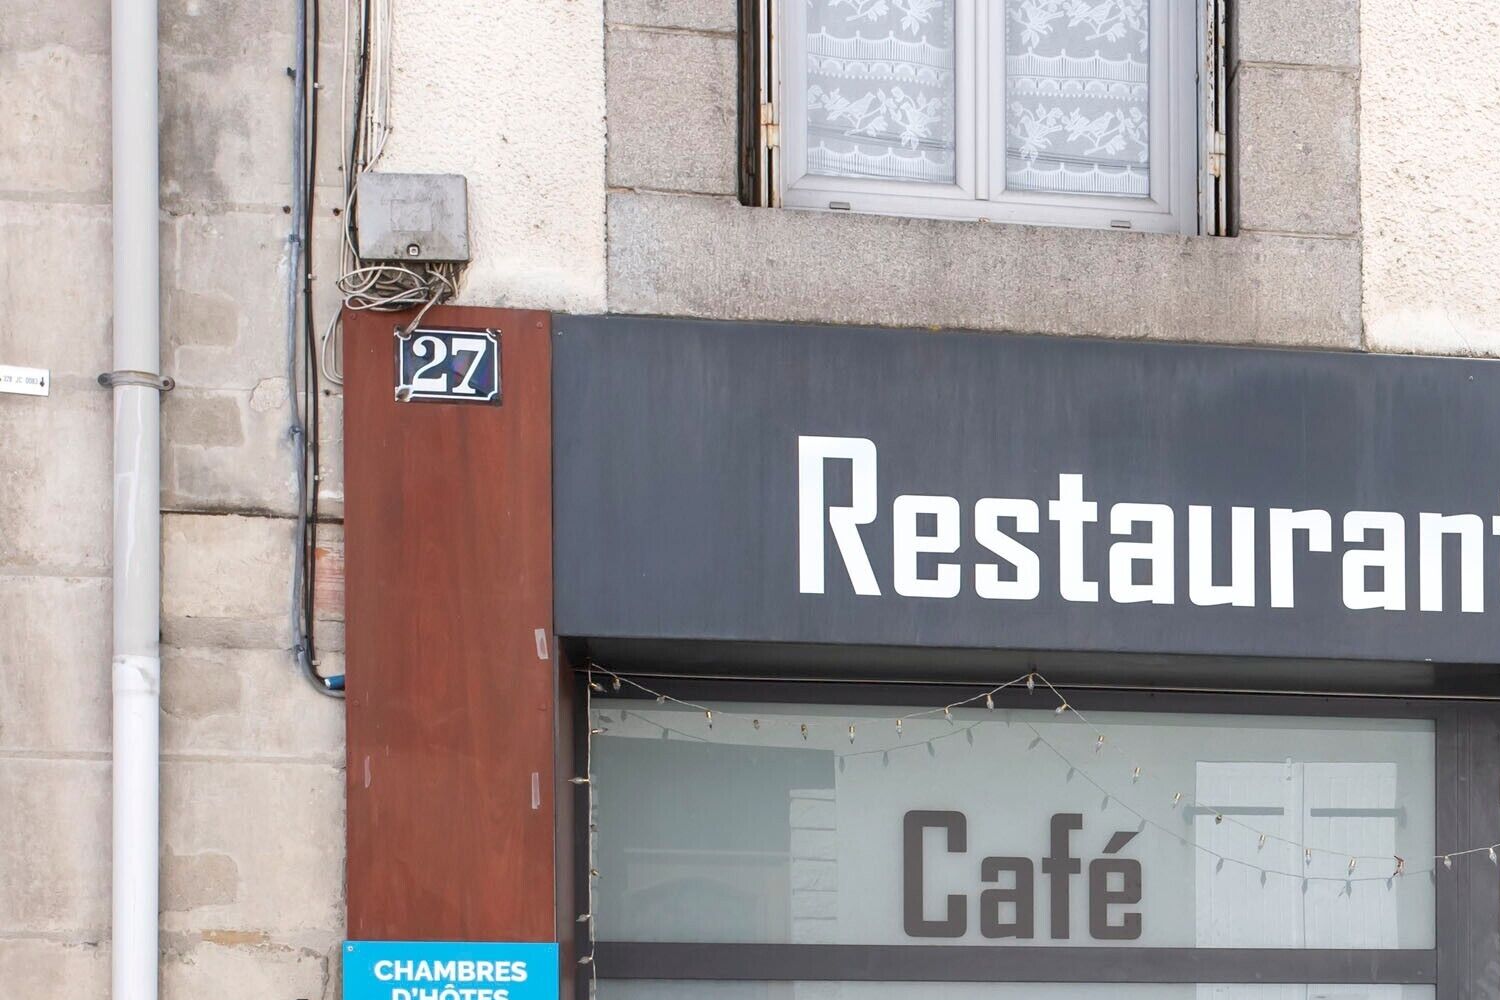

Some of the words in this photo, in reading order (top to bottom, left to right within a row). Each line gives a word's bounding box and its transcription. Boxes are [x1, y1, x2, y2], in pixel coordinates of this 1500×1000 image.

[412, 335, 487, 394] 27
[903, 810, 1143, 940] Café
[374, 960, 528, 983] CHAMBRES
